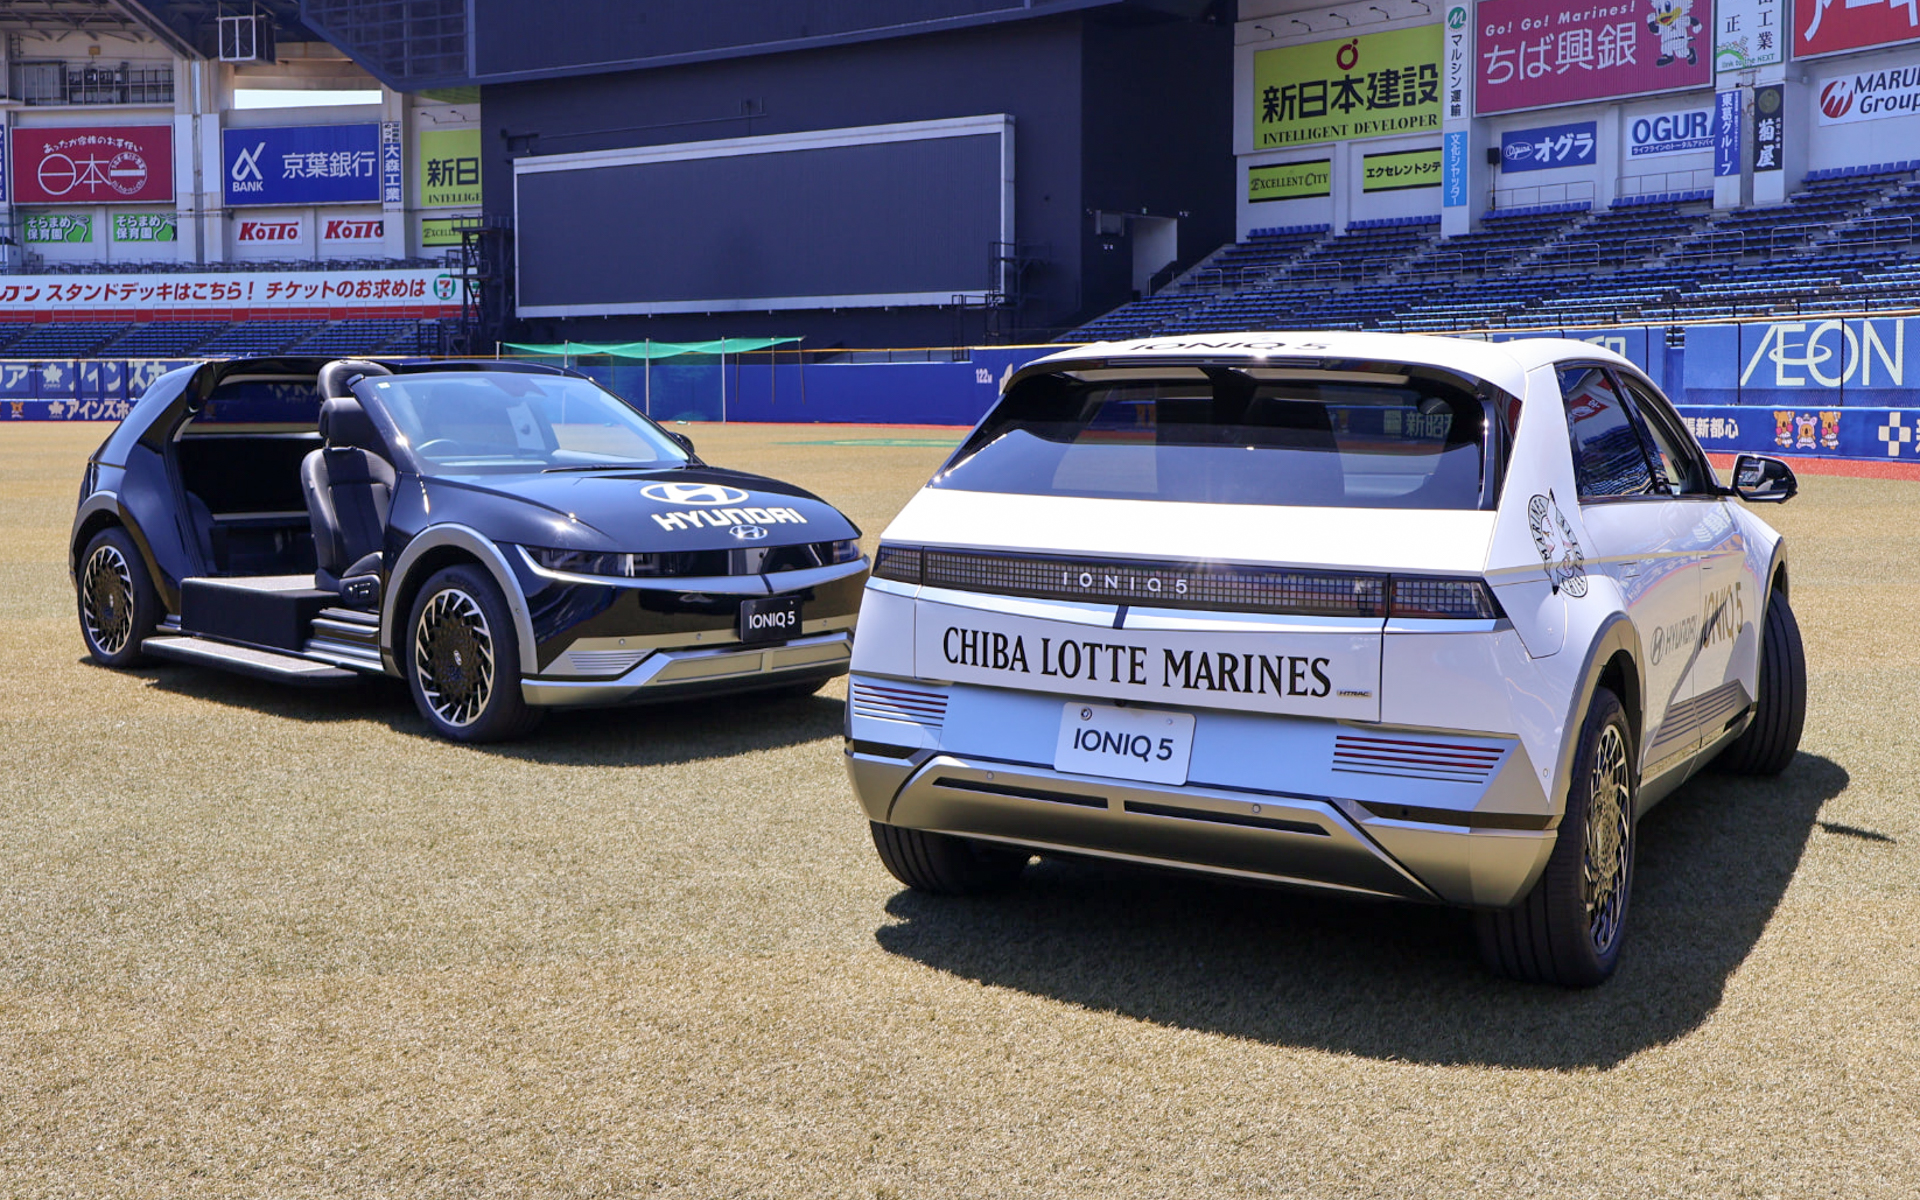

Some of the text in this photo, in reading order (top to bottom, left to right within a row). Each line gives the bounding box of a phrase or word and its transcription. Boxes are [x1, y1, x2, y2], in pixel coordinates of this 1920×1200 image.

[1485, 21, 1512, 37] Go!
[1520, 14, 1549, 31] Go!
[1557, 0, 1636, 24] Marines!
[1725, 14, 1741, 33] 正
[1757, 0, 1773, 51] 工業
[1483, 21, 1637, 84] ちば興銀
[1262, 63, 1439, 124] 新日本建設
[1860, 92, 1920, 115] Group
[1263, 113, 1438, 144] INTELLIGENT DEVELOPER
[1534, 132, 1594, 162] オグラ
[282, 151, 376, 179] 京葉銀行
[384, 144, 400, 202] 大森工業
[427, 157, 479, 187] 新日
[232, 181, 264, 192] BANK
[27, 215, 71, 229] そらまめ
[116, 214, 161, 228] そらまめ
[116, 227, 153, 240] 保育園
[27, 228, 63, 241] 保育園
[266, 278, 426, 299] チケットのお求めは
[66, 400, 134, 420] アインズホ
[651, 507, 809, 532] HYUNDAI
[1063, 571, 1188, 594] IONIQ 5
[749, 610, 796, 630] IONIQ 5
[1735, 581, 1743, 634] 5
[943, 626, 1332, 698] CHIBA LOTTE MARINES
[1073, 727, 1174, 763] IONIQ 5
